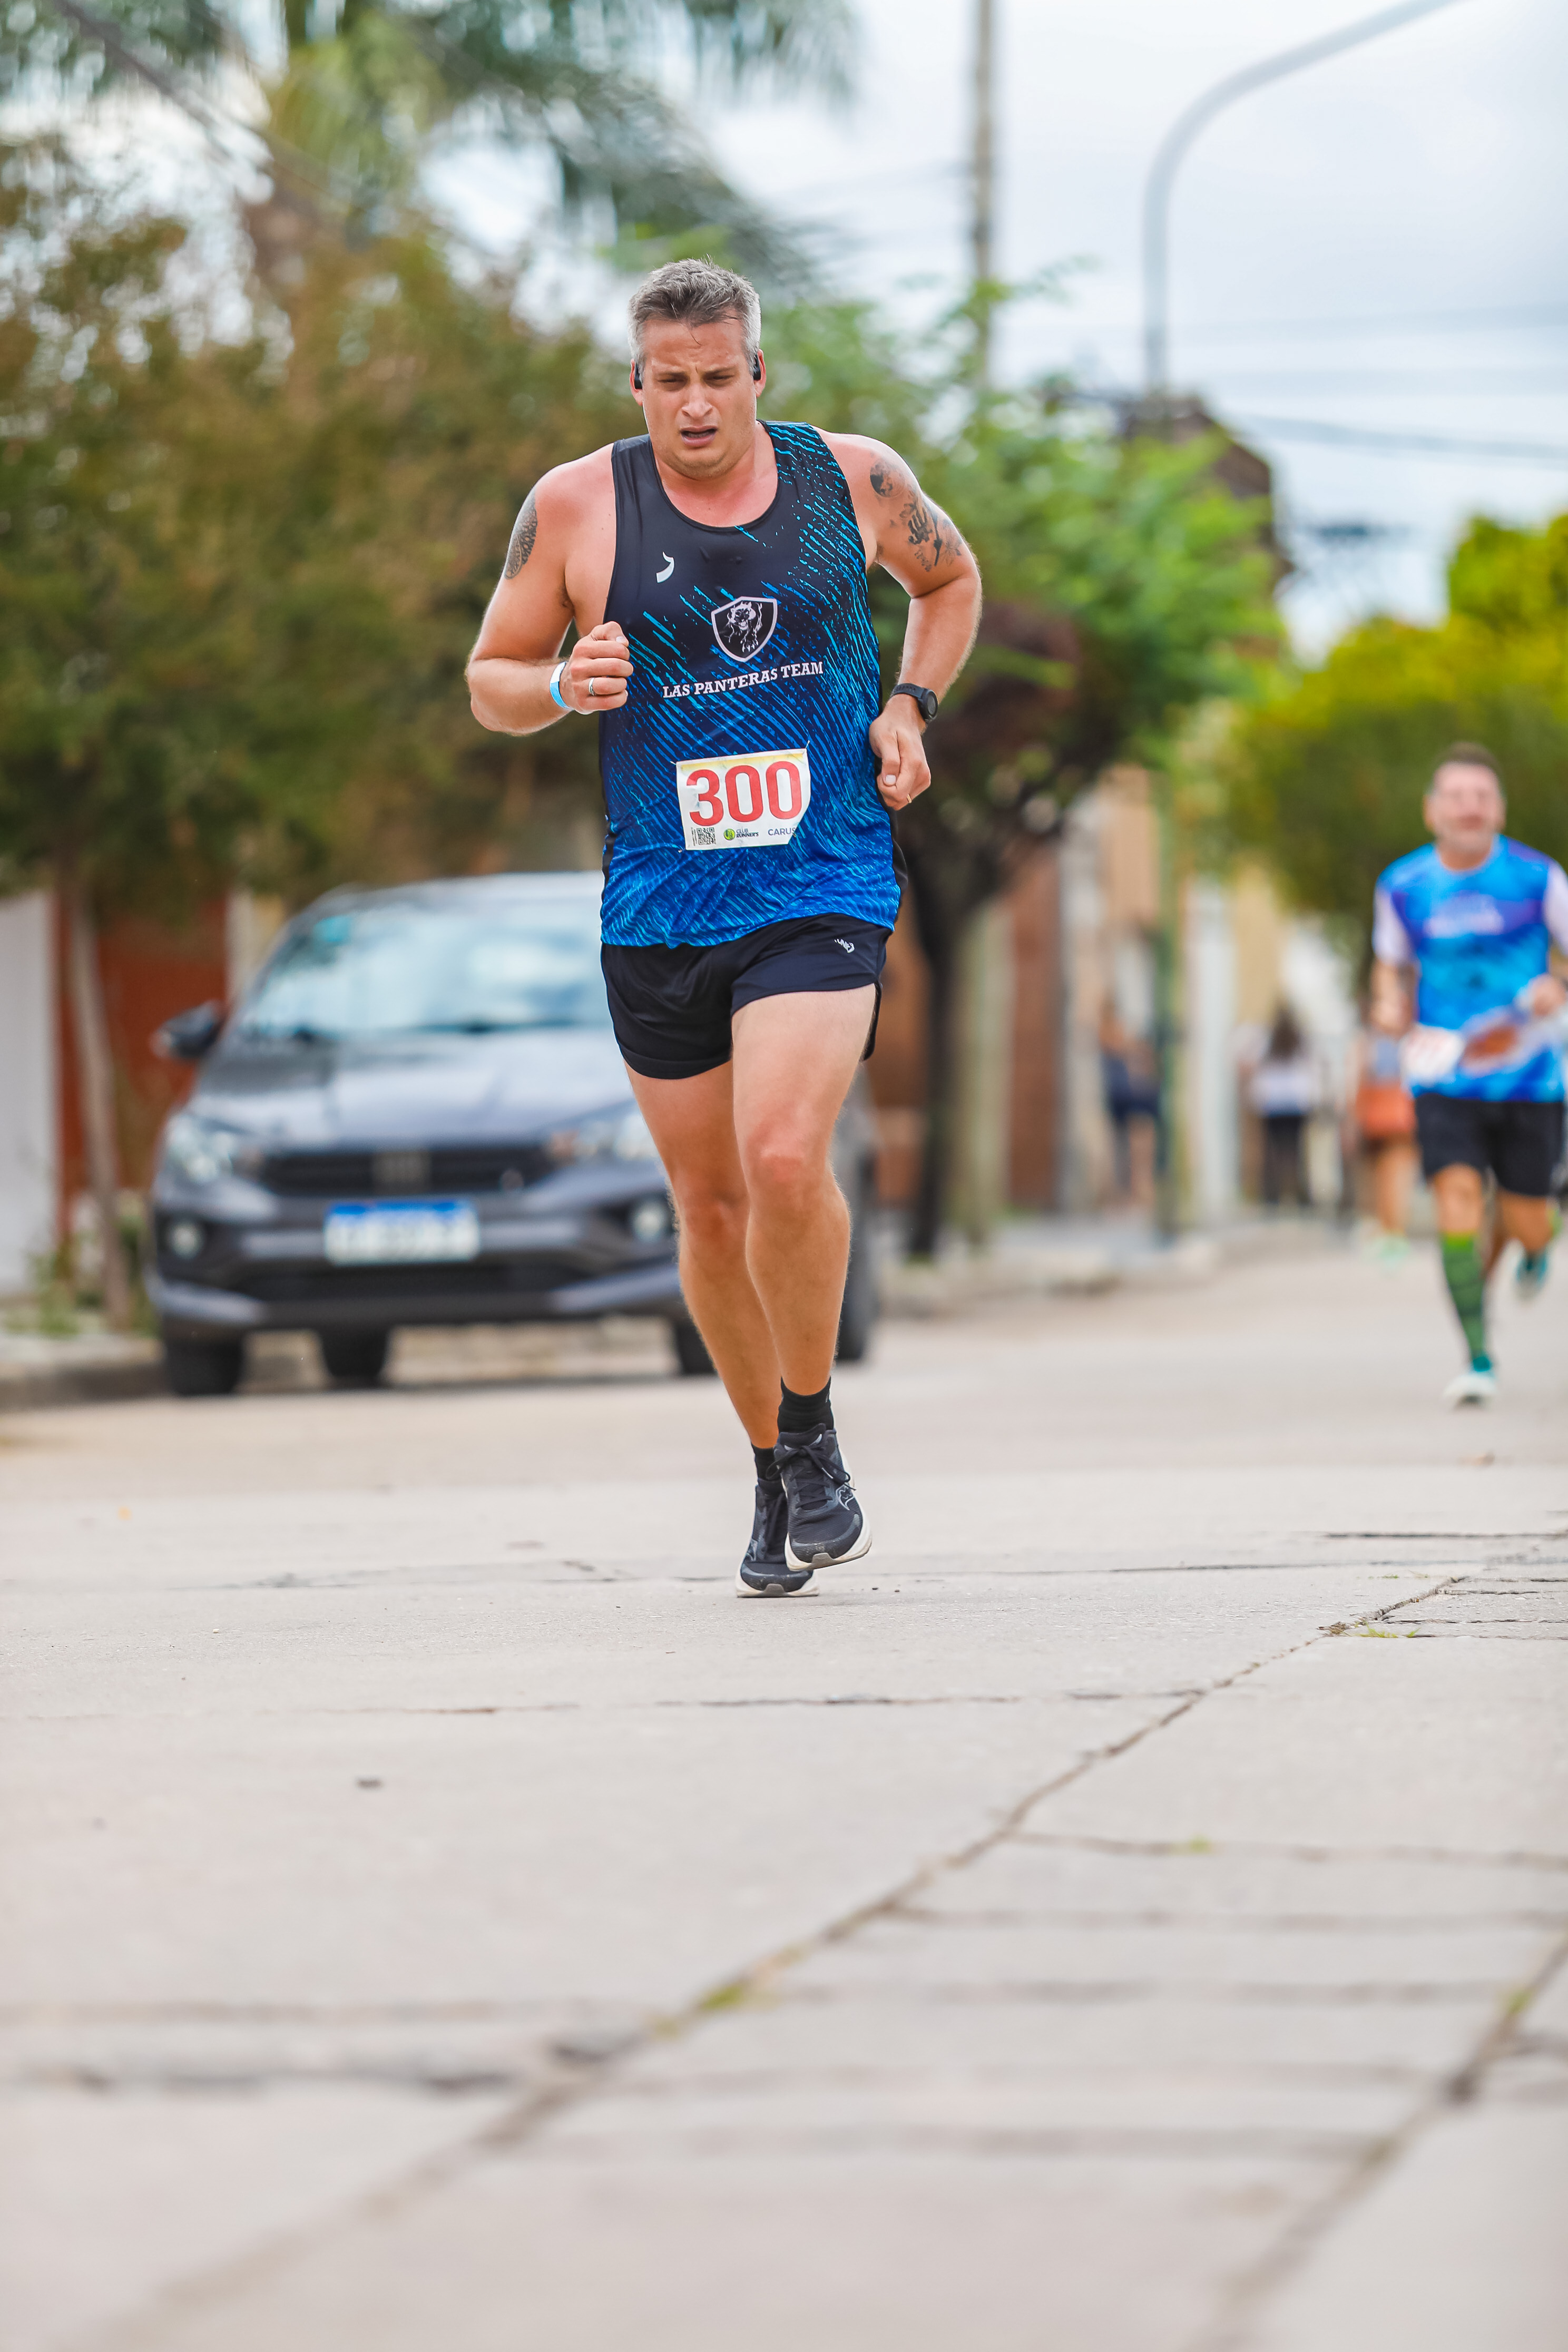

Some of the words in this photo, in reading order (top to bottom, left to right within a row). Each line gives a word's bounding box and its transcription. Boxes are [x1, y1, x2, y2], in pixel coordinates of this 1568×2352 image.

[662, 683, 691, 699] LAS
[693, 667, 778, 695] PANTERAS
[780, 661, 824, 679] TEAM
[686, 760, 802, 827] 300
